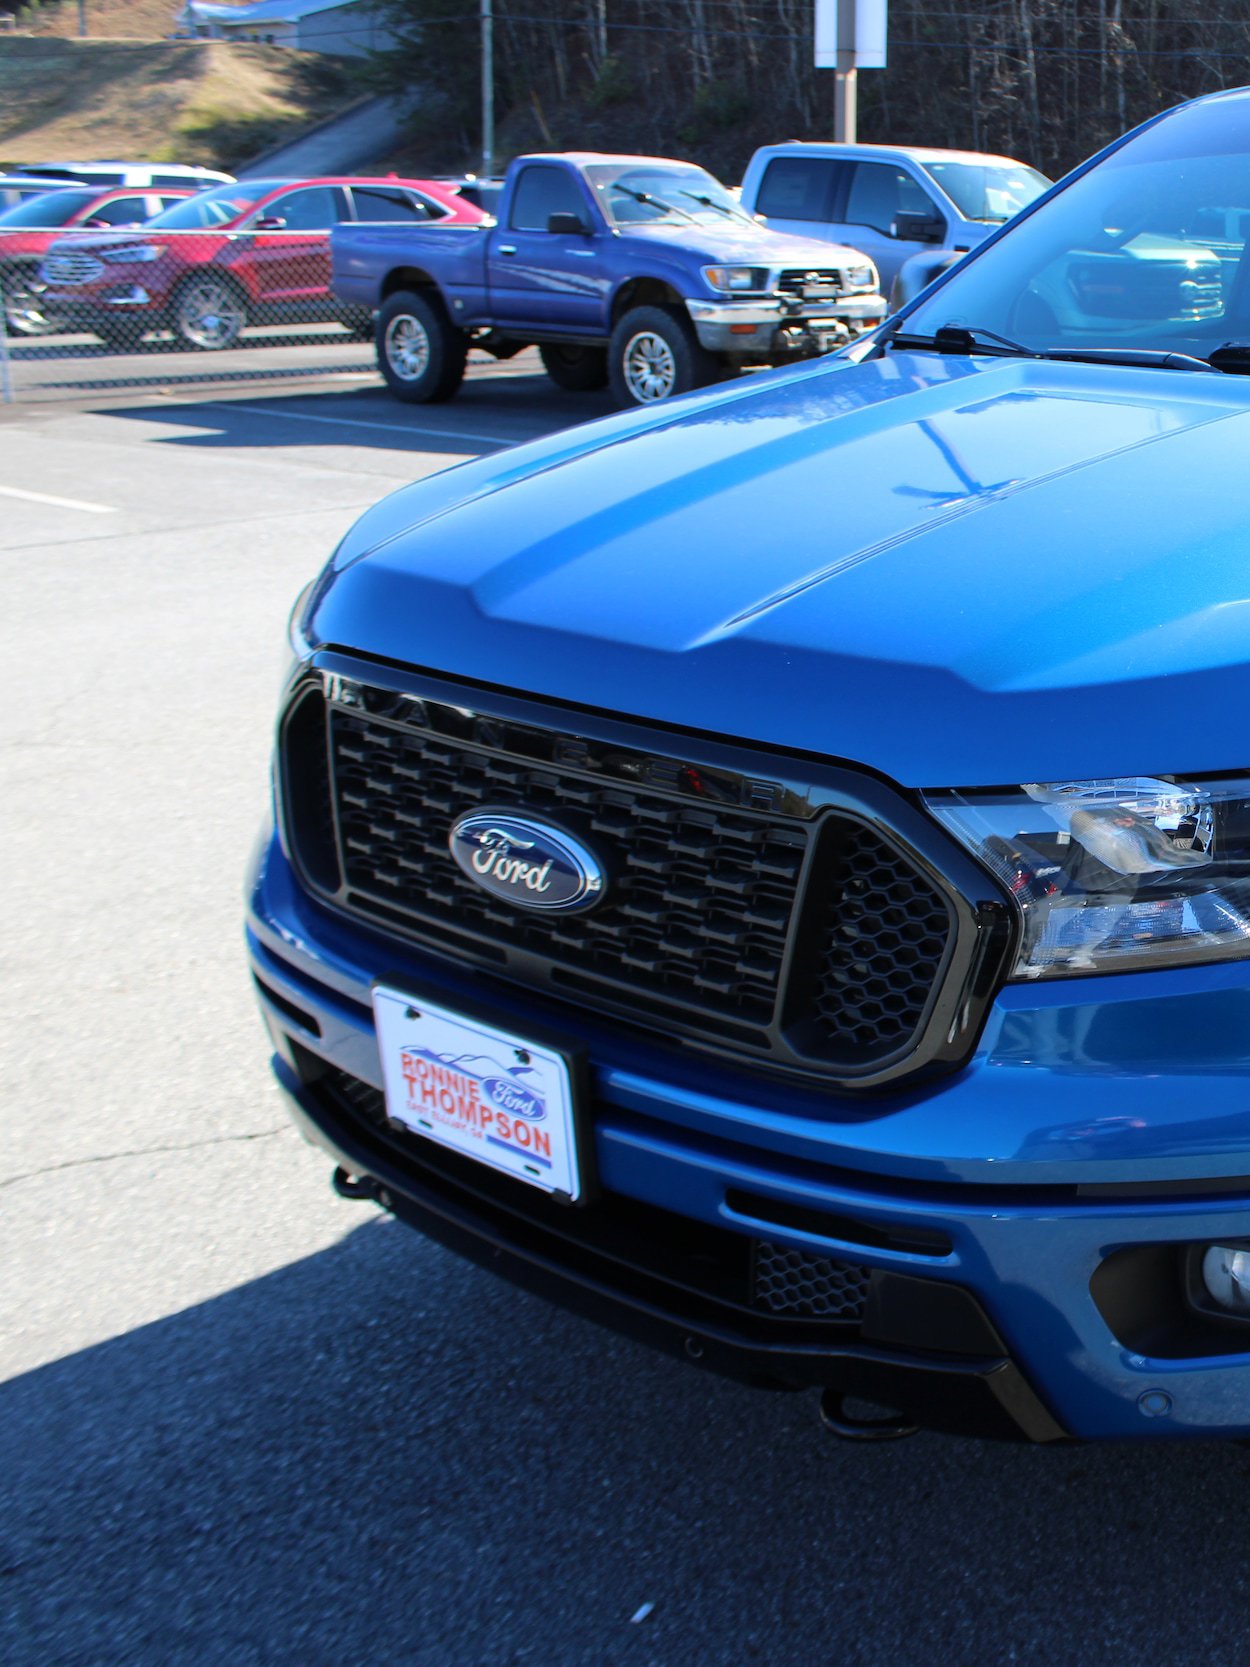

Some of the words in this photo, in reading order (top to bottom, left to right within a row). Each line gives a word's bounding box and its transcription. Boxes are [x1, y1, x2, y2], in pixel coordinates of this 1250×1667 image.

[472, 827, 554, 893] Ford
[401, 1053, 480, 1101] RONNIE
[492, 1081, 537, 1116] Ford
[402, 1074, 552, 1157] THOMPSON
